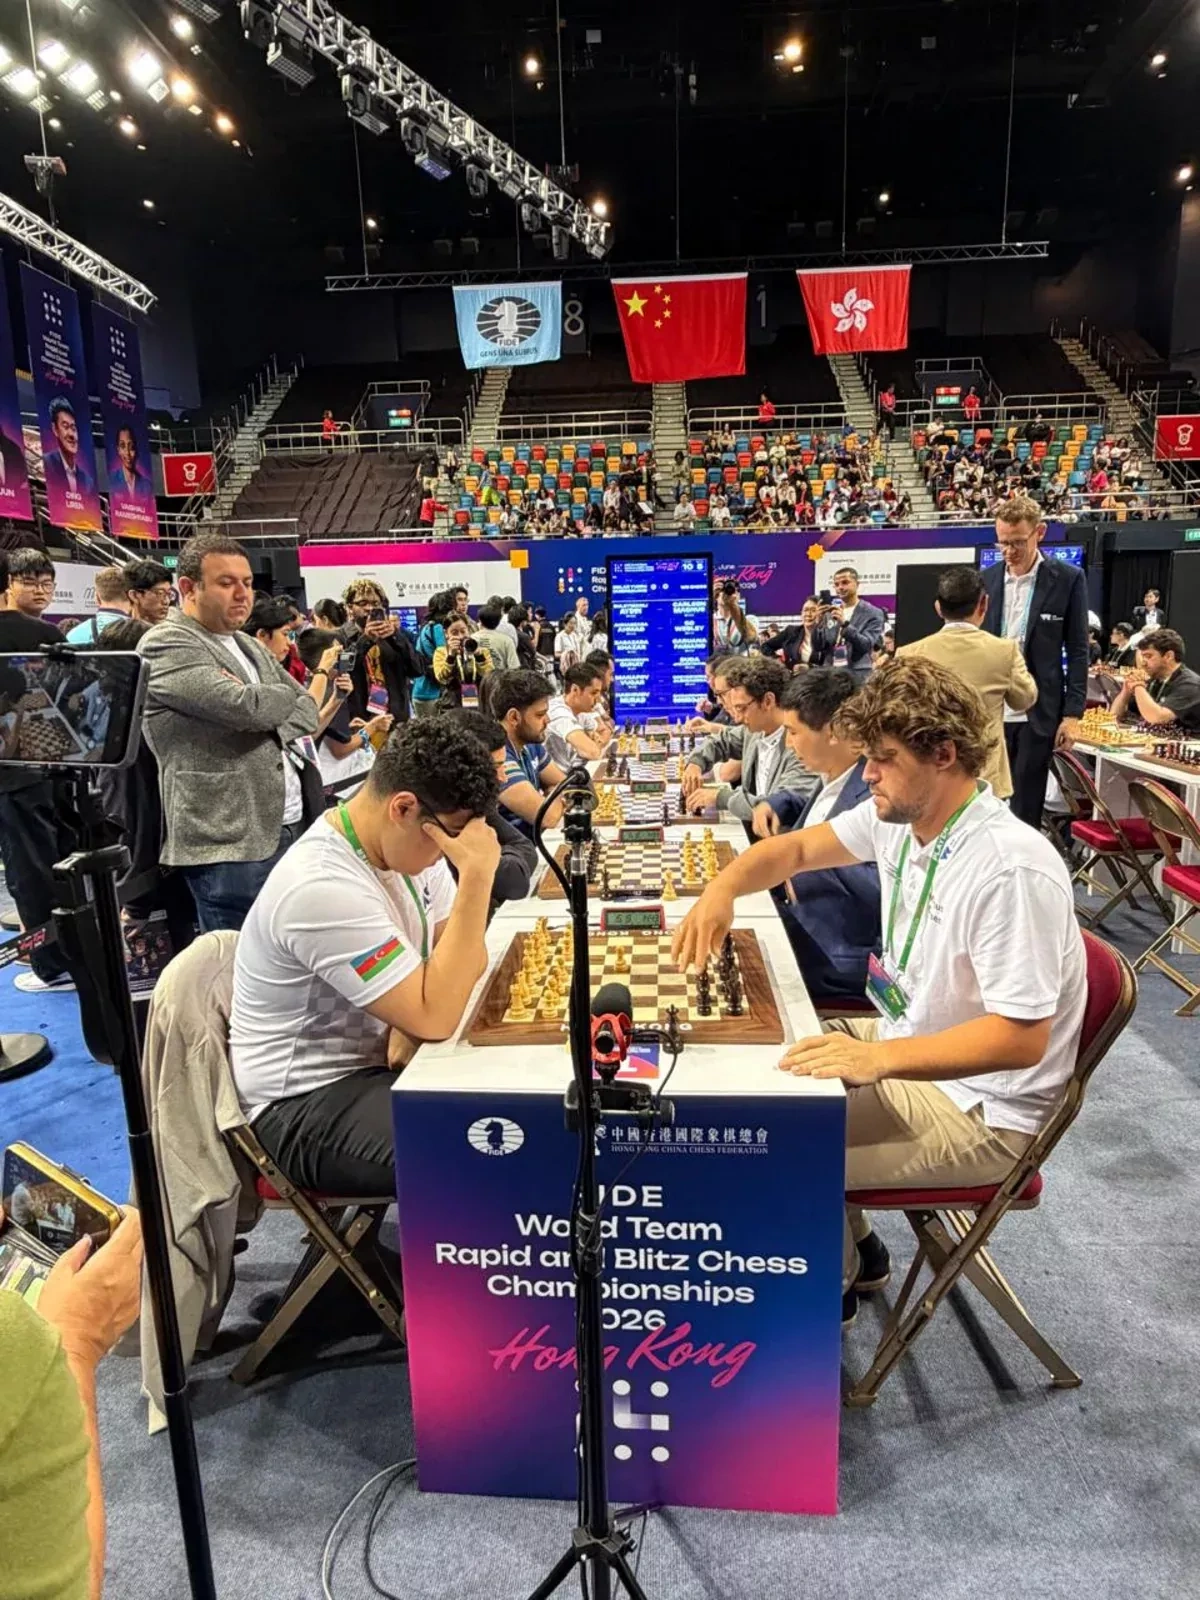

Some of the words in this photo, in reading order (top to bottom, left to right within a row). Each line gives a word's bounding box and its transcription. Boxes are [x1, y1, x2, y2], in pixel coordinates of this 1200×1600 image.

[564, 300, 584, 335] 8
[591, 567, 607, 575] FID
[661, 1145, 687, 1154] CHINA
[689, 1146, 715, 1154] CHESS
[717, 1146, 768, 1154] FEDERATION
[574, 1185, 663, 1208] IDE
[515, 1214, 618, 1239] Wod
[625, 1216, 722, 1240] Team
[435, 1243, 532, 1269] Rapid
[614, 1248, 690, 1271] Blitz
[698, 1250, 808, 1275] Chess
[574, 1308, 666, 1330] 026
[627, 1321, 757, 1388] Kong
